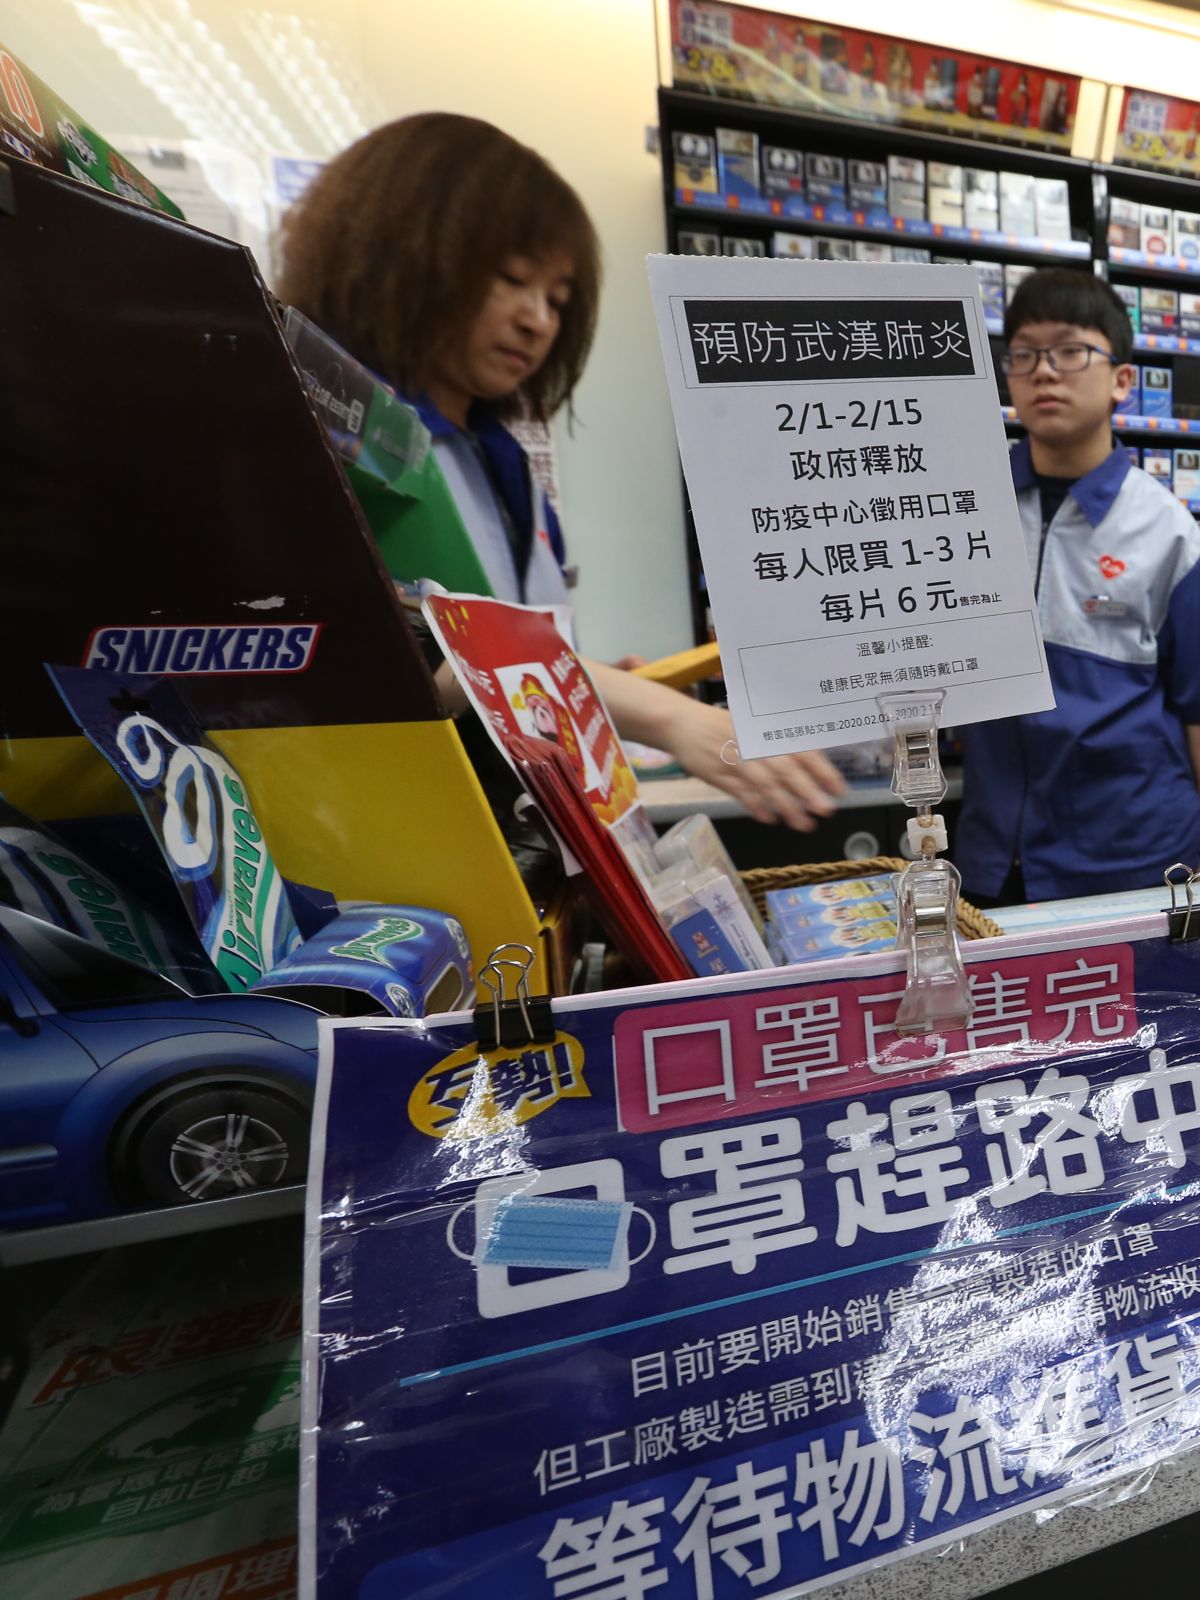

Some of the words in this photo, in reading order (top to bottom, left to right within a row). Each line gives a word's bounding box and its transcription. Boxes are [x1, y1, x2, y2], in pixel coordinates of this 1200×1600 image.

[693, 319, 970, 365] 預防武漢肺炎
[775, 398, 922, 434] 2/1-2/15
[791, 443, 927, 482] 政府釋放
[752, 490, 979, 534] 防疫中心徵用口罩
[753, 542, 893, 583] 每人限買
[902, 535, 954, 566] 1-3
[967, 530, 991, 559] 片
[820, 589, 885, 624] 每片
[897, 588, 917, 615] 6
[92, 626, 313, 673] SNICKERS
[856, 634, 934, 658] 溫馨小提醒:
[819, 657, 980, 694] 健康民眾無須隨時戴口罩
[215, 774, 264, 993] Airwaves
[643, 958, 1122, 1115] 口罩已售完
[631, 1222, 1160, 1398] 目前要開始銷售灣製造的口罩
